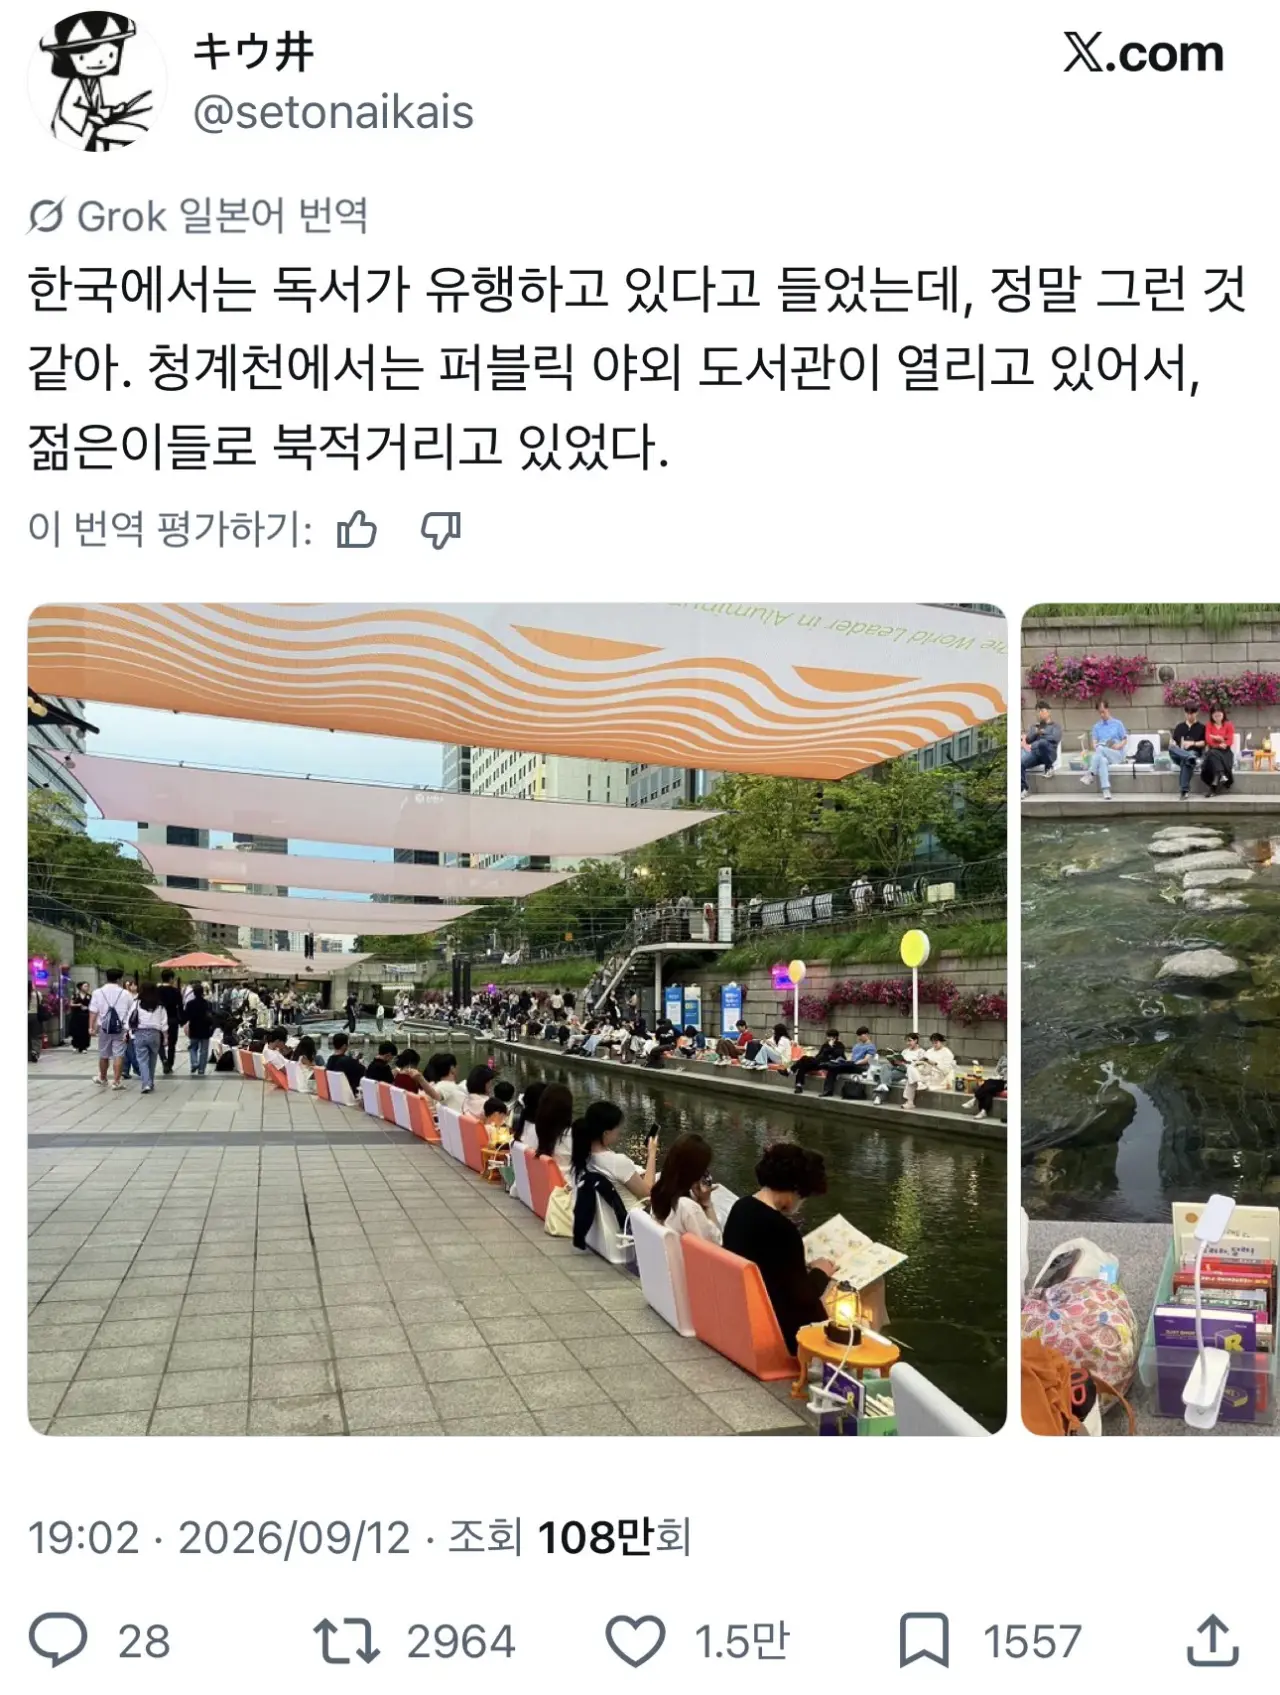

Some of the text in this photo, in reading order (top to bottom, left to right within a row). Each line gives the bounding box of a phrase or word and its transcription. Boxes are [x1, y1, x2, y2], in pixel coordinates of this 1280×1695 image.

[194, 30, 314, 72] キウ井
[195, 92, 473, 134] @setonaikais
[78, 197, 367, 235] Grok 일본어 번역
[28, 265, 1246, 319] 한국에서는 독서가 유행하고 있다고 들었는데, 정말 그런 것
[29, 343, 1199, 397] 같아. 청계천에서는 퍼블릭 야외 도서관이 열리고 있어서,
[29, 423, 668, 471] 젊은이들로 북적거리고 있었다.
[30, 510, 312, 549] 이 번역 평가하기:
[796, 614, 821, 631] in
[824, 619, 906, 642] Leader
[906, 630, 976, 651] World
[30, 1516, 690, 1561] 19:02 2026/09/12 조회 108만회
[119, 1624, 170, 1658] 28
[408, 1624, 516, 1659] 2964
[696, 1620, 791, 1660] 1.5만
[985, 1624, 1083, 1659] 1557
